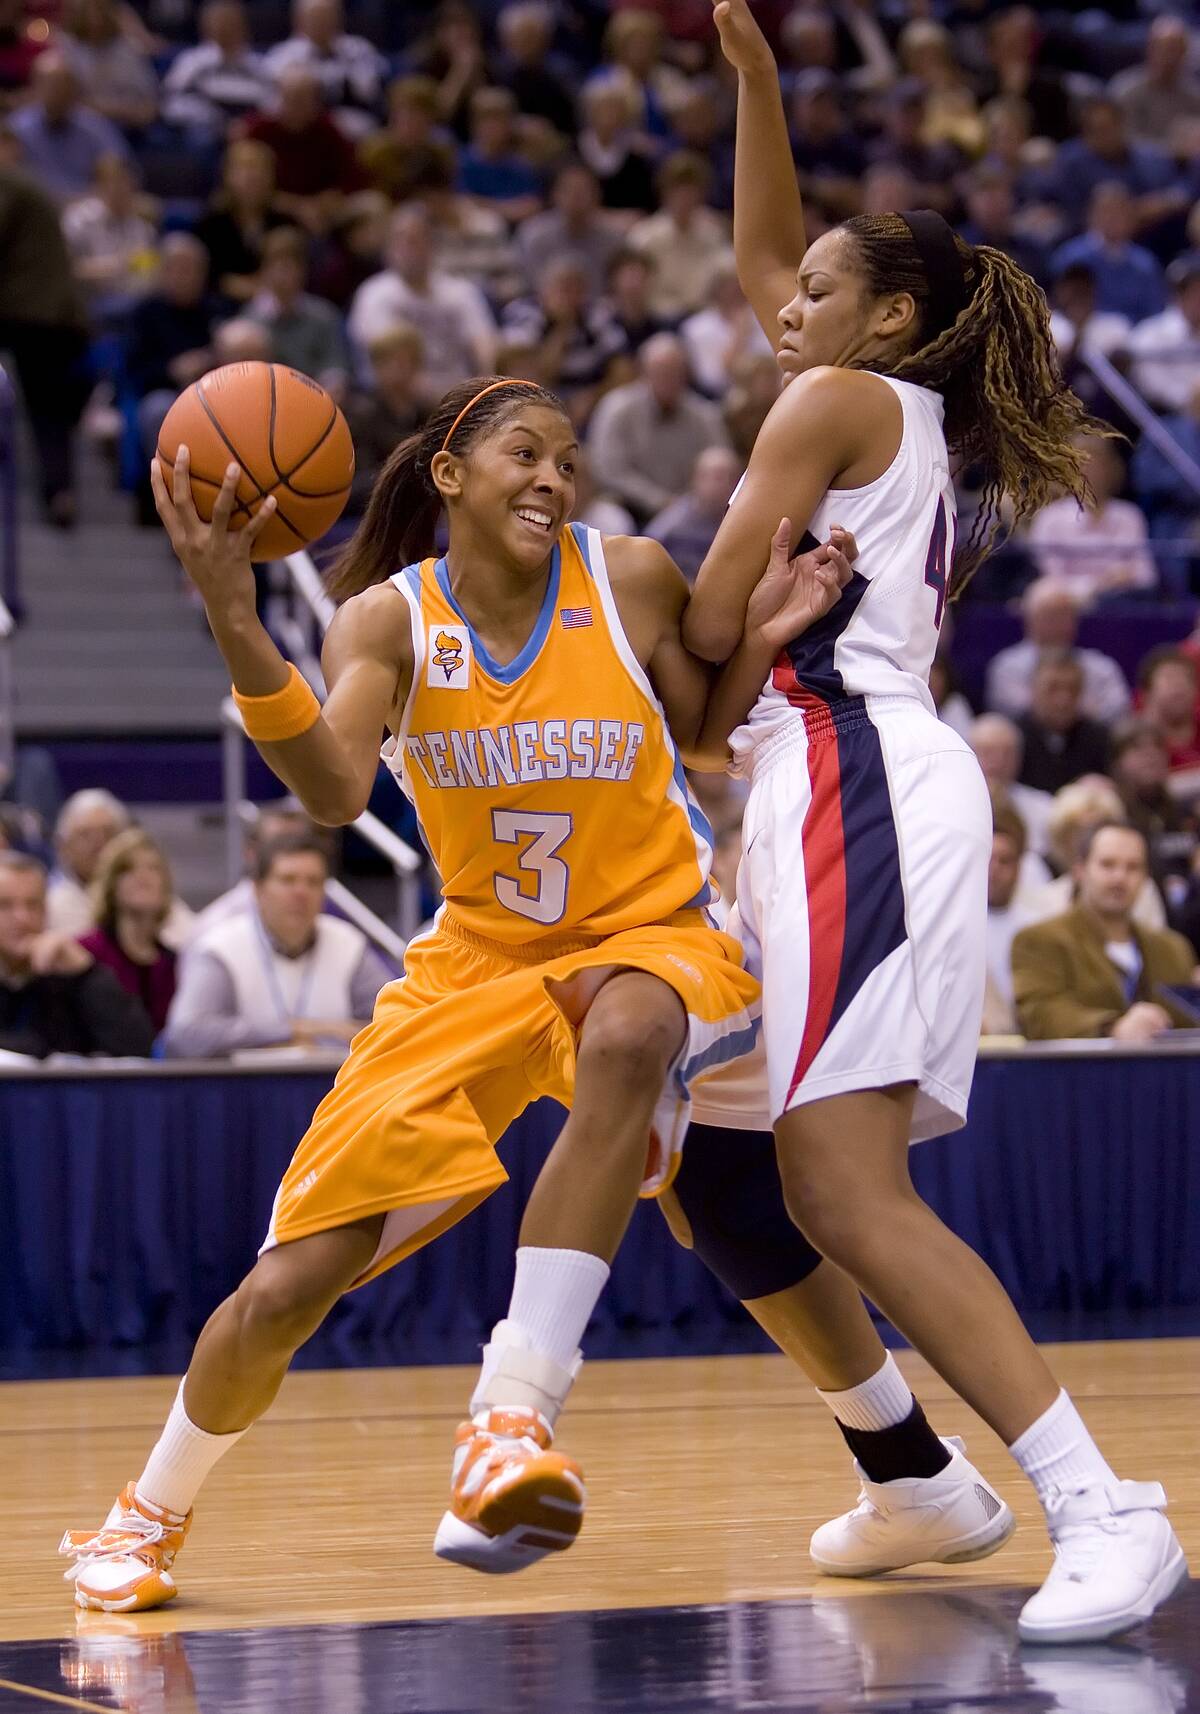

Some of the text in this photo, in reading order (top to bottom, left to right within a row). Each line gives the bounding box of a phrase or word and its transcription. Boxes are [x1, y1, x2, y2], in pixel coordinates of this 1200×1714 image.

[925, 491, 957, 631] 4
[406, 719, 644, 788] TENNESSEE
[490, 807, 574, 926] 3
